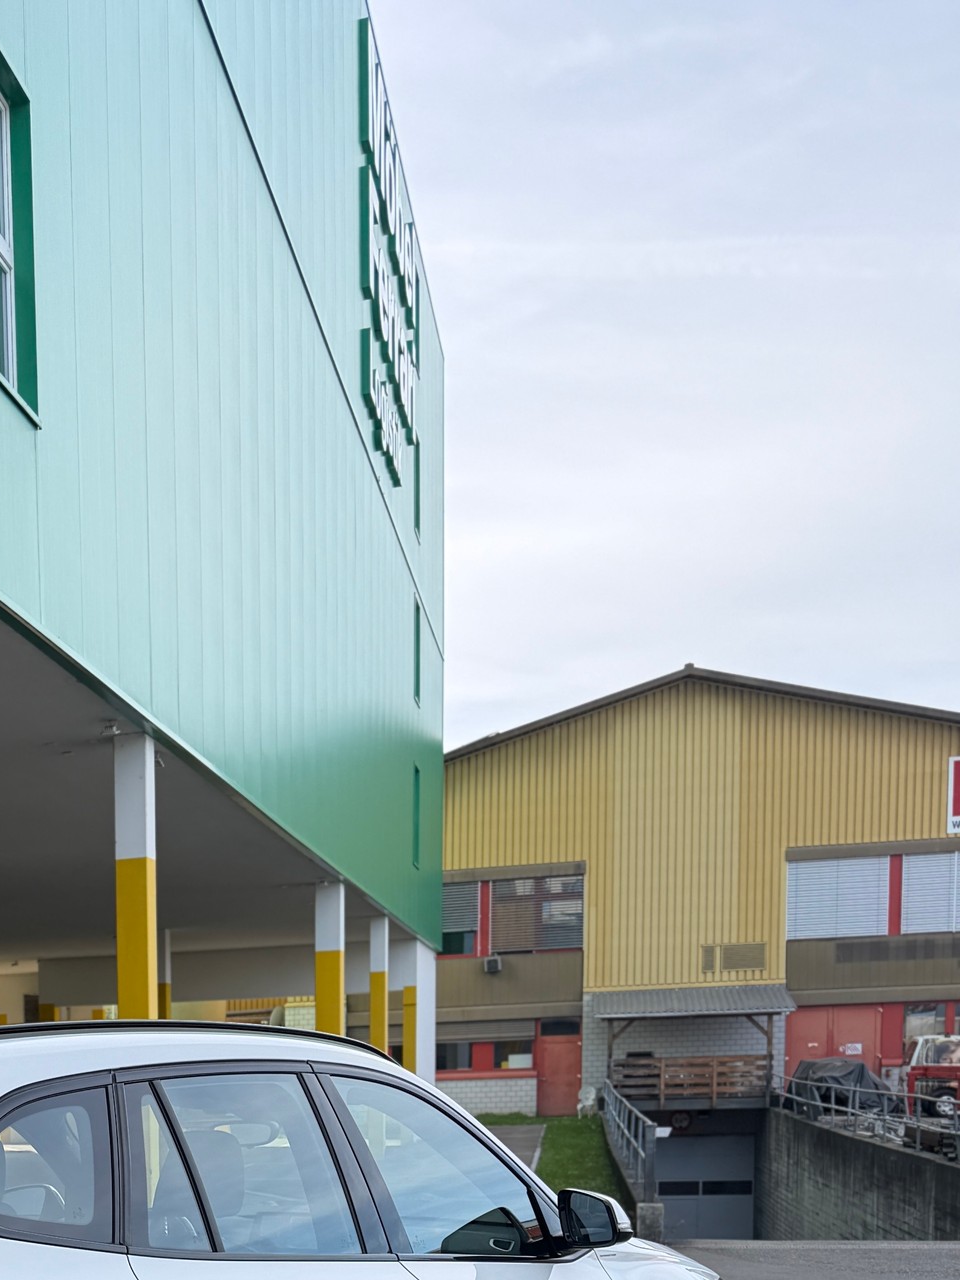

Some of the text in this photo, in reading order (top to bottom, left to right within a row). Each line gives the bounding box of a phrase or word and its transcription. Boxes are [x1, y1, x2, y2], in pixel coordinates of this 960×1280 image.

[359, 17, 415, 330] Möbel
[359, 165, 418, 446] Ferrari
[360, 328, 402, 488] Logistik
